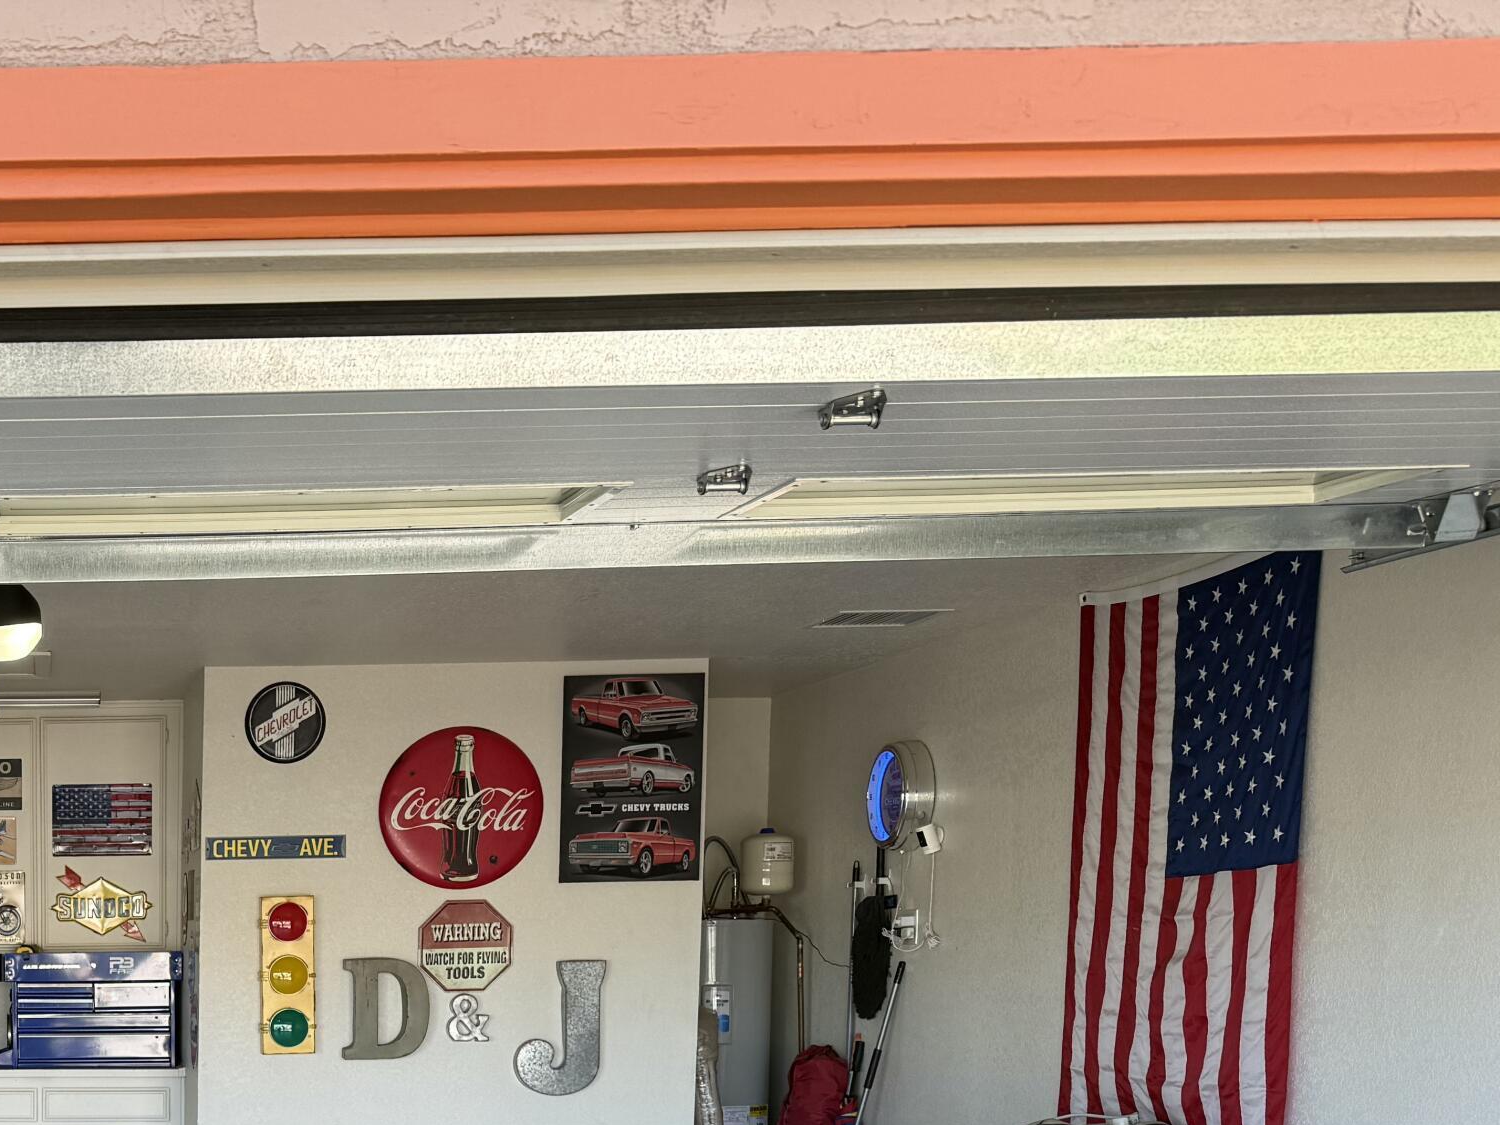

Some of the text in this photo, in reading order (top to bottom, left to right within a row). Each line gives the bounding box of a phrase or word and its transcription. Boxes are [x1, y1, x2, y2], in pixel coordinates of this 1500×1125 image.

[257, 697, 315, 744] CHEVROLET
[390, 786, 536, 831] Coca-Cola
[621, 803, 690, 812] CHEVY TRUCKS
[212, 837, 339, 858] CHEVY AVE.
[57, 894, 145, 919] SUNOCO
[431, 922, 503, 942] WARNING
[425, 951, 507, 965] WATCH FOR FLYING
[445, 965, 485, 980] TOOLS
[341, 957, 607, 1096] D & J
